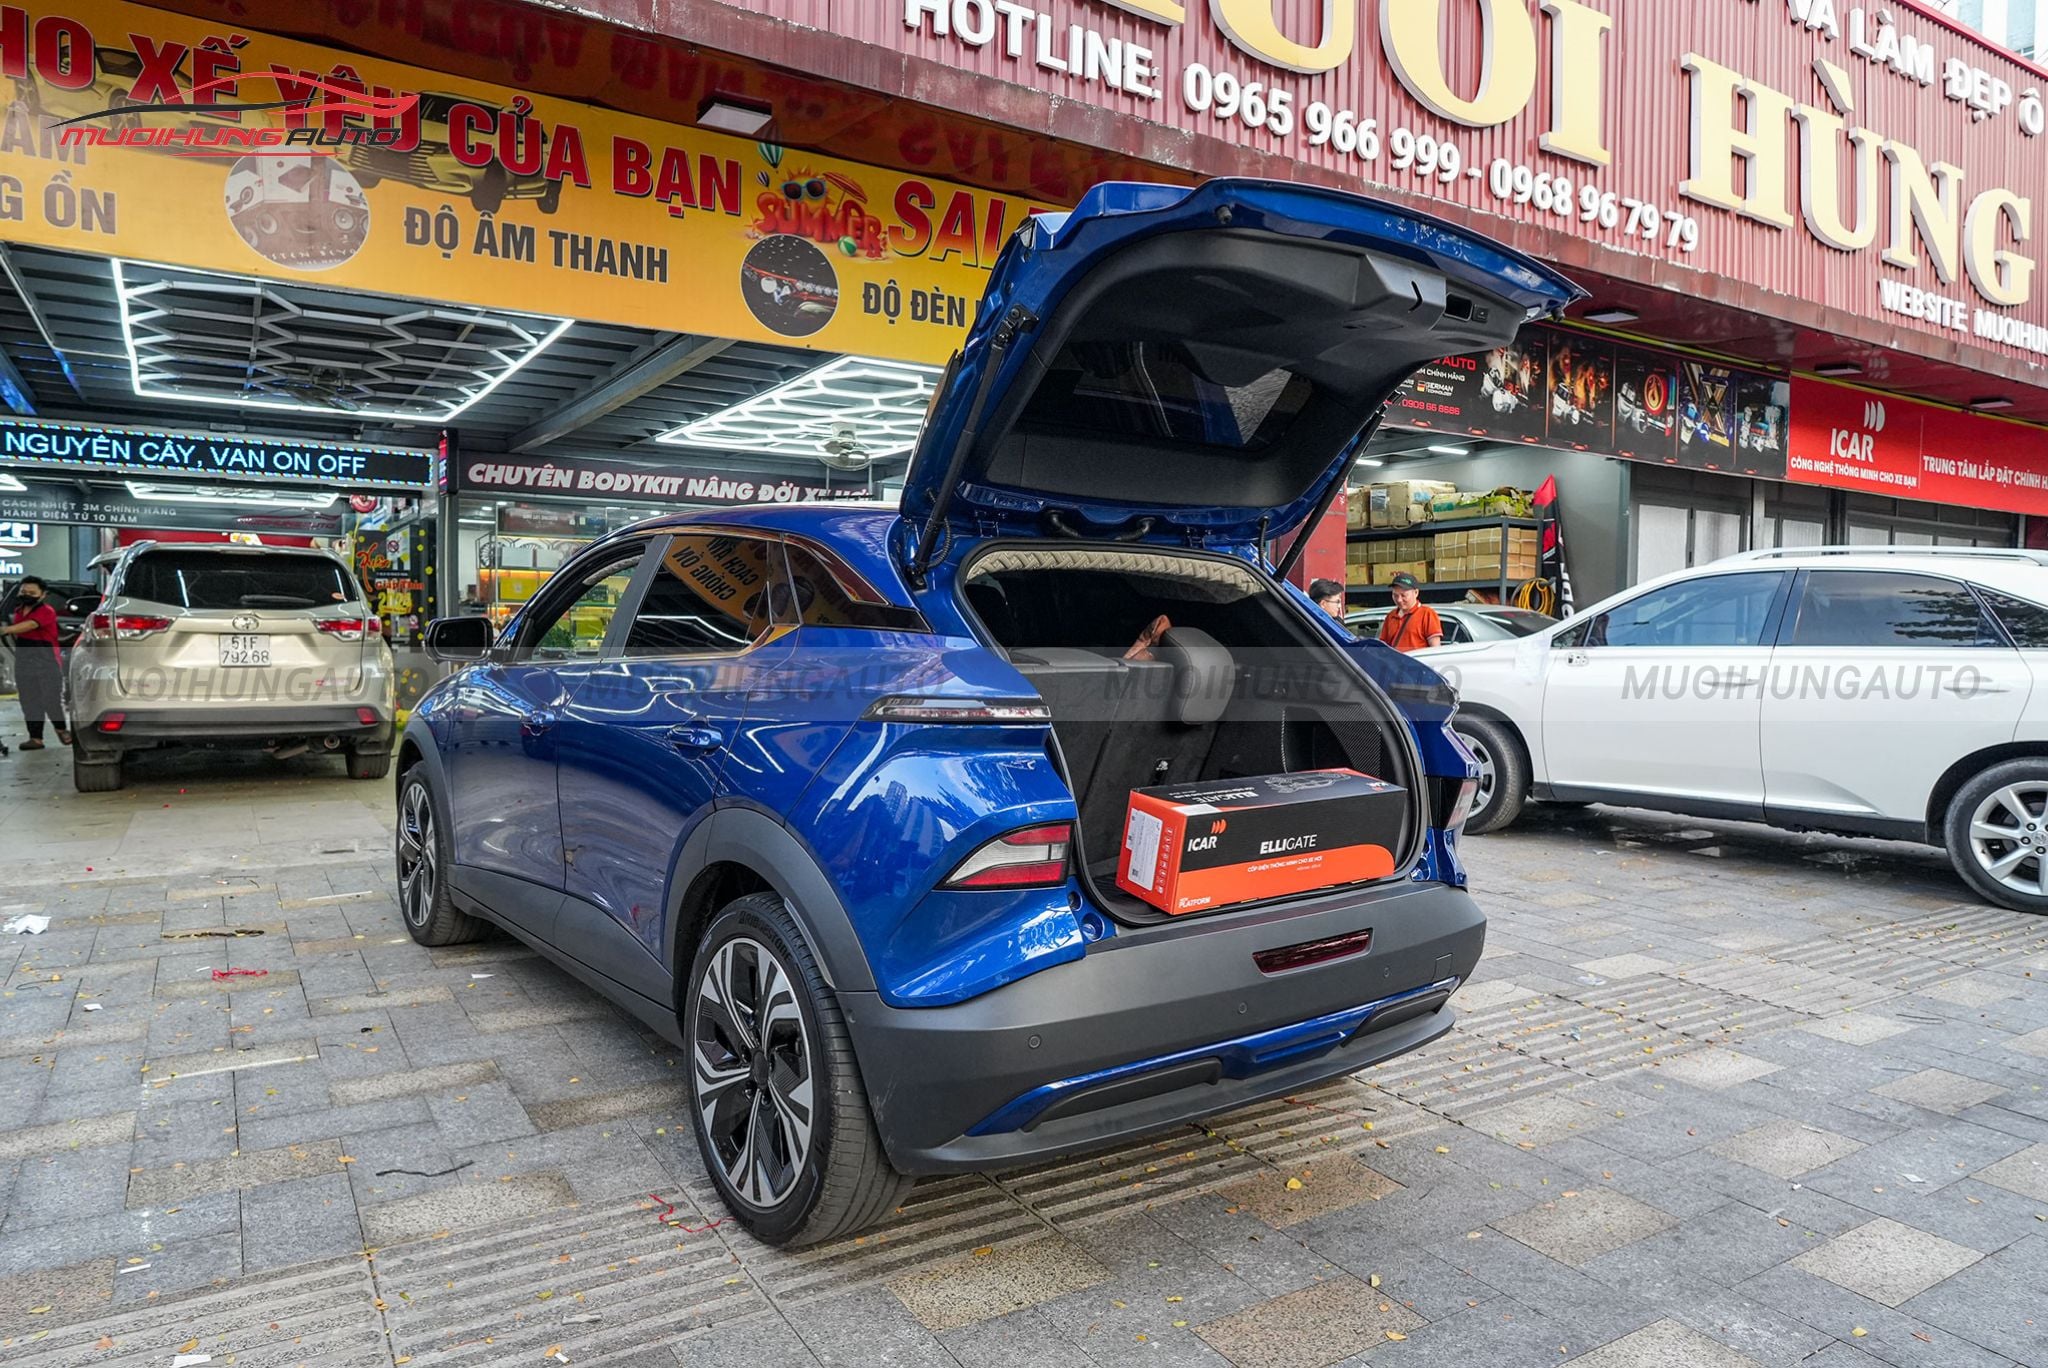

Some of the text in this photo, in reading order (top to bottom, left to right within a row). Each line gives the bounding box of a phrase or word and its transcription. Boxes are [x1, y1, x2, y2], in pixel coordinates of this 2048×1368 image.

[1849, 8, 1935, 86] LÀM
[1943, 57, 2013, 122] ĐẸP
[2018, 87, 2045, 136] Ô
[127, 34, 250, 122] XẾ
[448, 95, 592, 189] CỦA
[612, 135, 741, 218] BẠN
[1183, 62, 1294, 137] 0965
[1305, 100, 1380, 161] 966
[1489, 158, 1574, 217] 0968
[1579, 184, 1619, 230] 96
[1621, 197, 1660, 241] 79
[1663, 210, 1700, 253] 79
[1679, 52, 2036, 307] HÙNG
[44, 169, 117, 235] ỒN
[404, 205, 668, 284] ĐỘ ÂM THANH
[862, 279, 901, 326] ĐỘ
[911, 286, 965, 328] ĐÈN
[1879, 278, 1969, 333] WEBSITE
[6, 431, 367, 476] NGUYÊN CÂY, VAN ON OFF
[1829, 428, 1875, 463] ICAR
[467, 463, 574, 489] CHUYÊN
[577, 471, 685, 496] BODYKIT
[685, 475, 754, 501] NÂNG
[1790, 456, 1813, 471] CÔNG
[1814, 460, 1835, 477] NGHỆ
[1835, 463, 1860, 478] THÔNG
[1860, 467, 1879, 481] MINH
[1879, 471, 1895, 484] CHO
[1894, 474, 1903, 486] XE
[1923, 455, 1956, 476] TRUNG
[1957, 459, 1977, 479] TÂM
[1978, 459, 1996, 481] LẮP
[1996, 466, 2014, 488] ĐẶT
[2014, 469, 2041, 489] CHÍNH
[83, 503, 100, 512] 3M
[231, 636, 258, 650] 51F
[1187, 836, 1218, 853] ICAR
[1260, 834, 1318, 855] ELLIGATE
